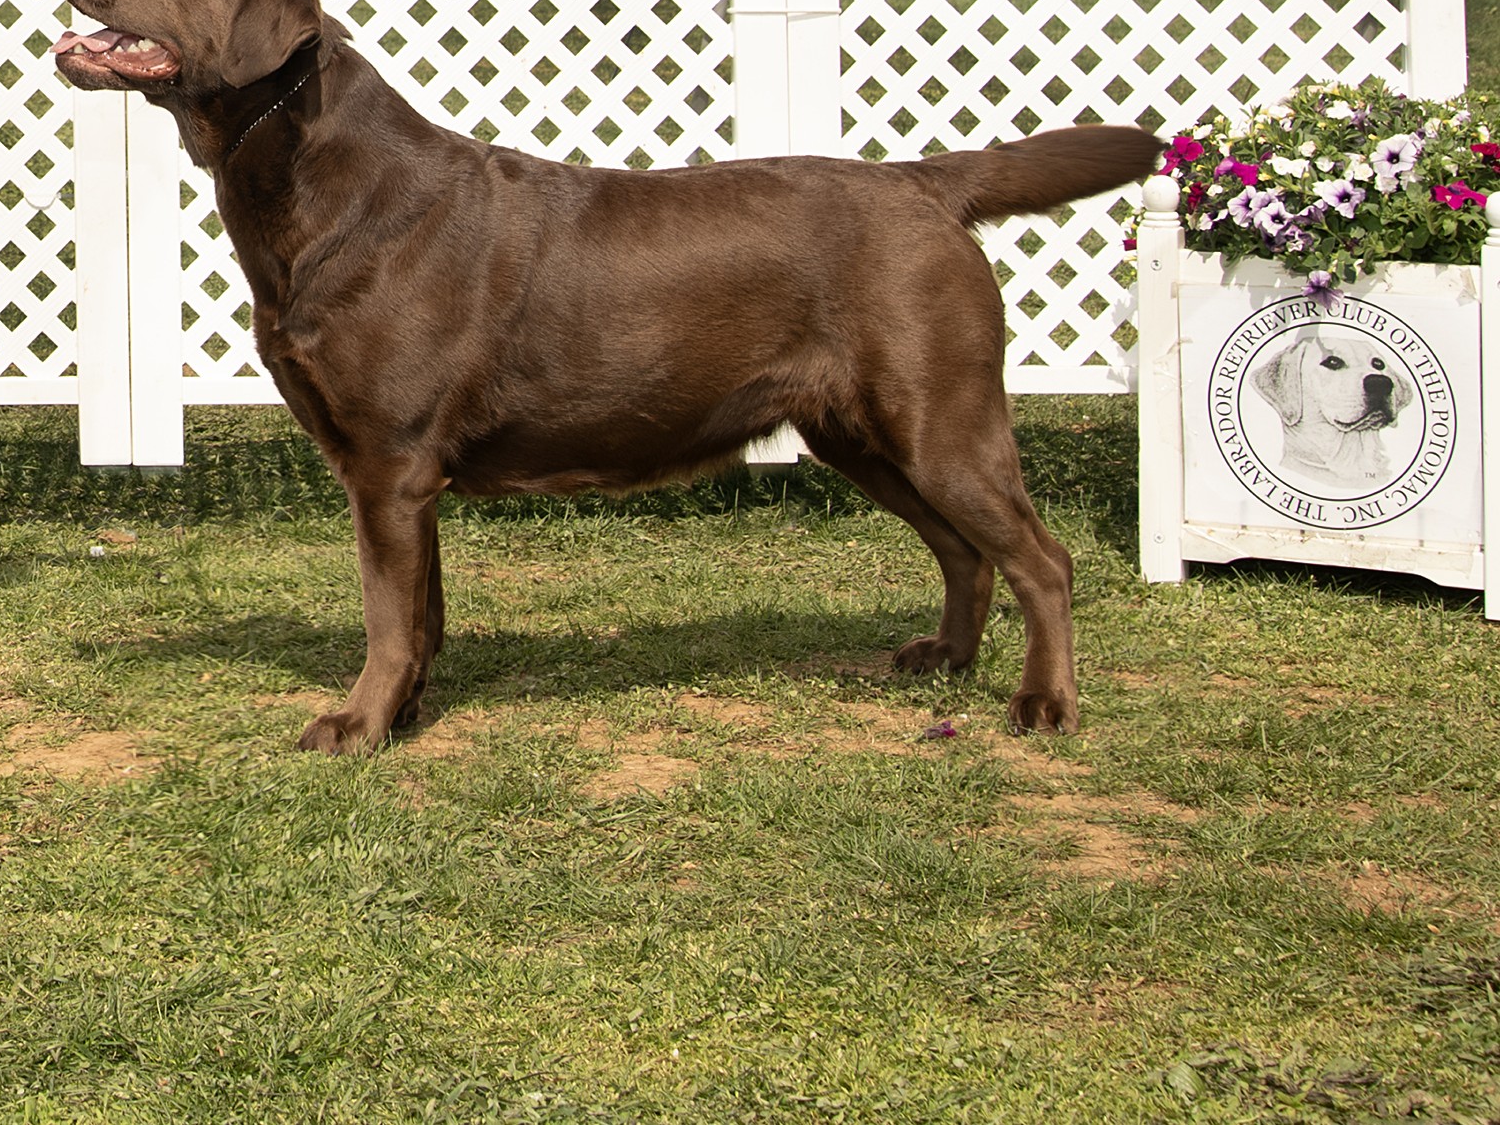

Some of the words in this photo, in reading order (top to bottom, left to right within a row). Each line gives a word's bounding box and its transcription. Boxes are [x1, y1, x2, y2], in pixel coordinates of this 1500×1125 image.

[1326, 301, 1388, 332] CLUB
[1219, 299, 1321, 385] RETRIEVER
[1389, 328, 1421, 358] OF
[1415, 354, 1446, 404] THE
[1215, 386, 1280, 499] LABRADOR
[1384, 409, 1449, 508] POTOMAC,
[1279, 491, 1328, 523] THE
[1337, 499, 1386, 524] INC.
